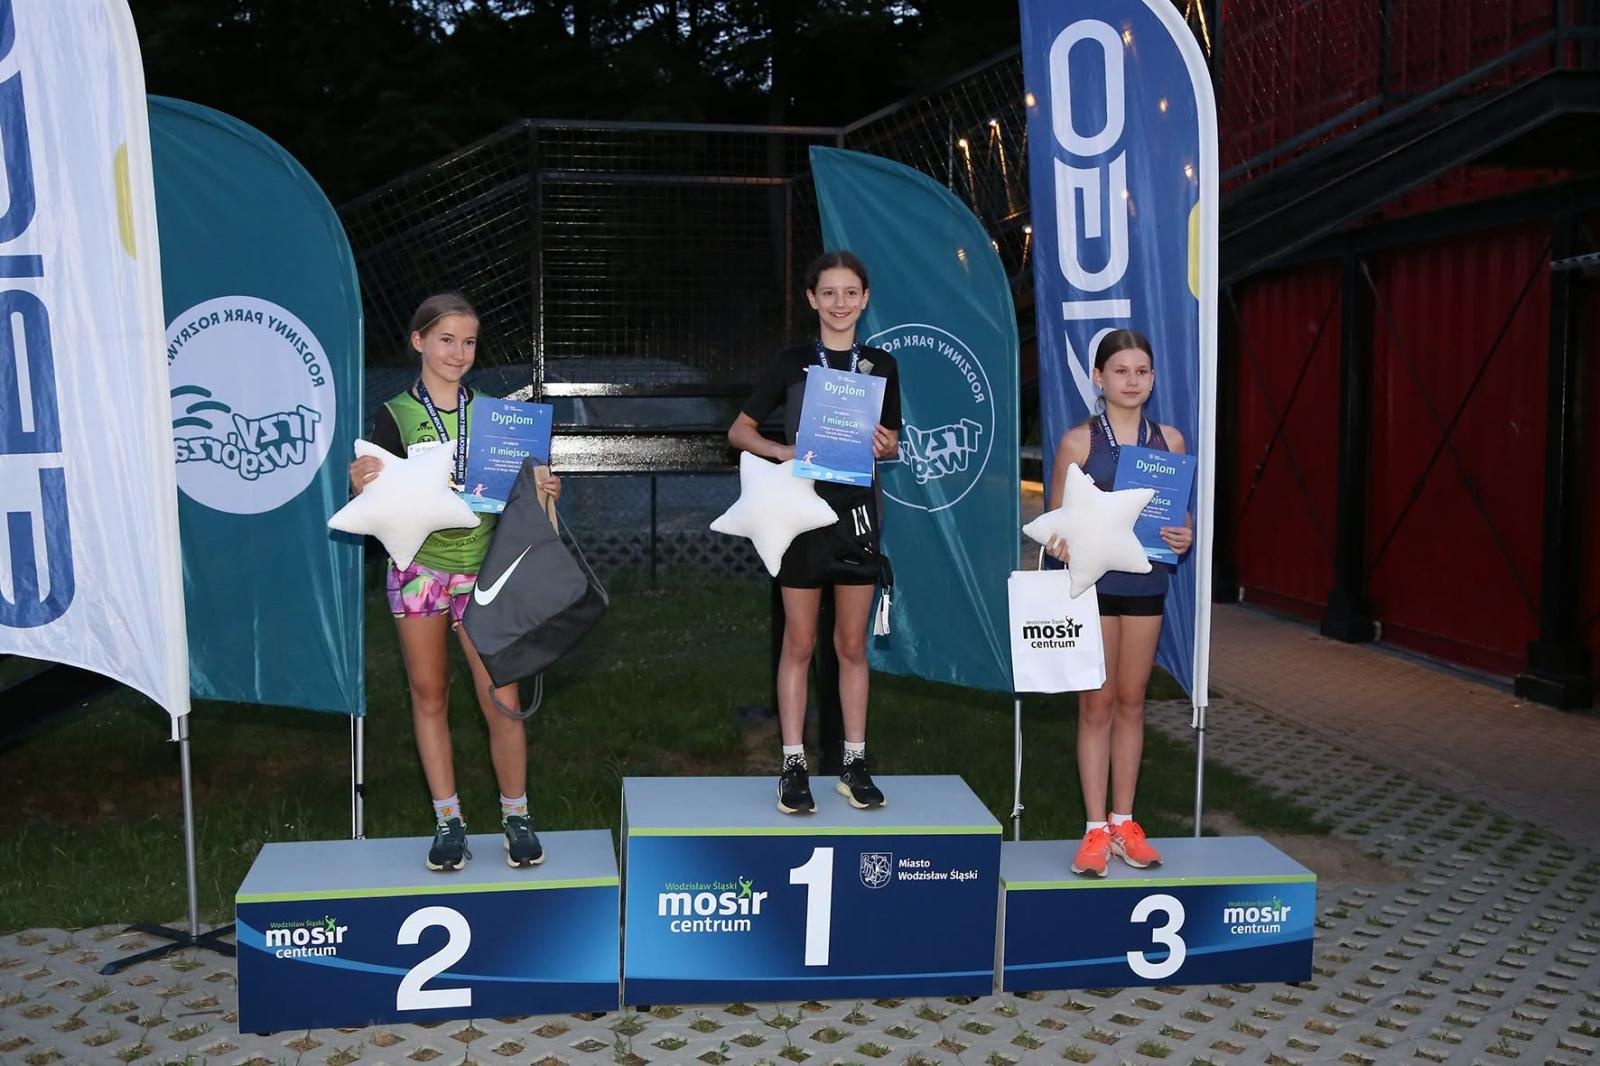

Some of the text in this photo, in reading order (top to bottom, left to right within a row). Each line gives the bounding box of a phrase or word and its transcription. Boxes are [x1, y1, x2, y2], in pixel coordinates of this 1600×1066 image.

[824, 381, 866, 397] Dyplom
[491, 411, 533, 425] Dyplom
[827, 416, 858, 428] miejsca
[490, 446, 530, 458] II miejsca
[1136, 459, 1176, 475] Dyplom
[1151, 496, 1171, 506] ejsca
[1022, 623, 1083, 639] mosir
[1031, 640, 1076, 648] centrum
[898, 858, 931, 868] Miasto
[897, 869, 978, 882] Wodzisław Śląski
[665, 881, 738, 892] Wodzisław Śląski
[658, 891, 768, 916] mosir
[789, 846, 834, 967] 1
[1223, 905, 1292, 924] mosir
[670, 917, 751, 933] centrum
[1230, 923, 1281, 935] centrum
[265, 925, 348, 947] mosir
[1127, 893, 1187, 980] 3
[275, 946, 337, 959] centrum
[396, 906, 472, 1011] 2
